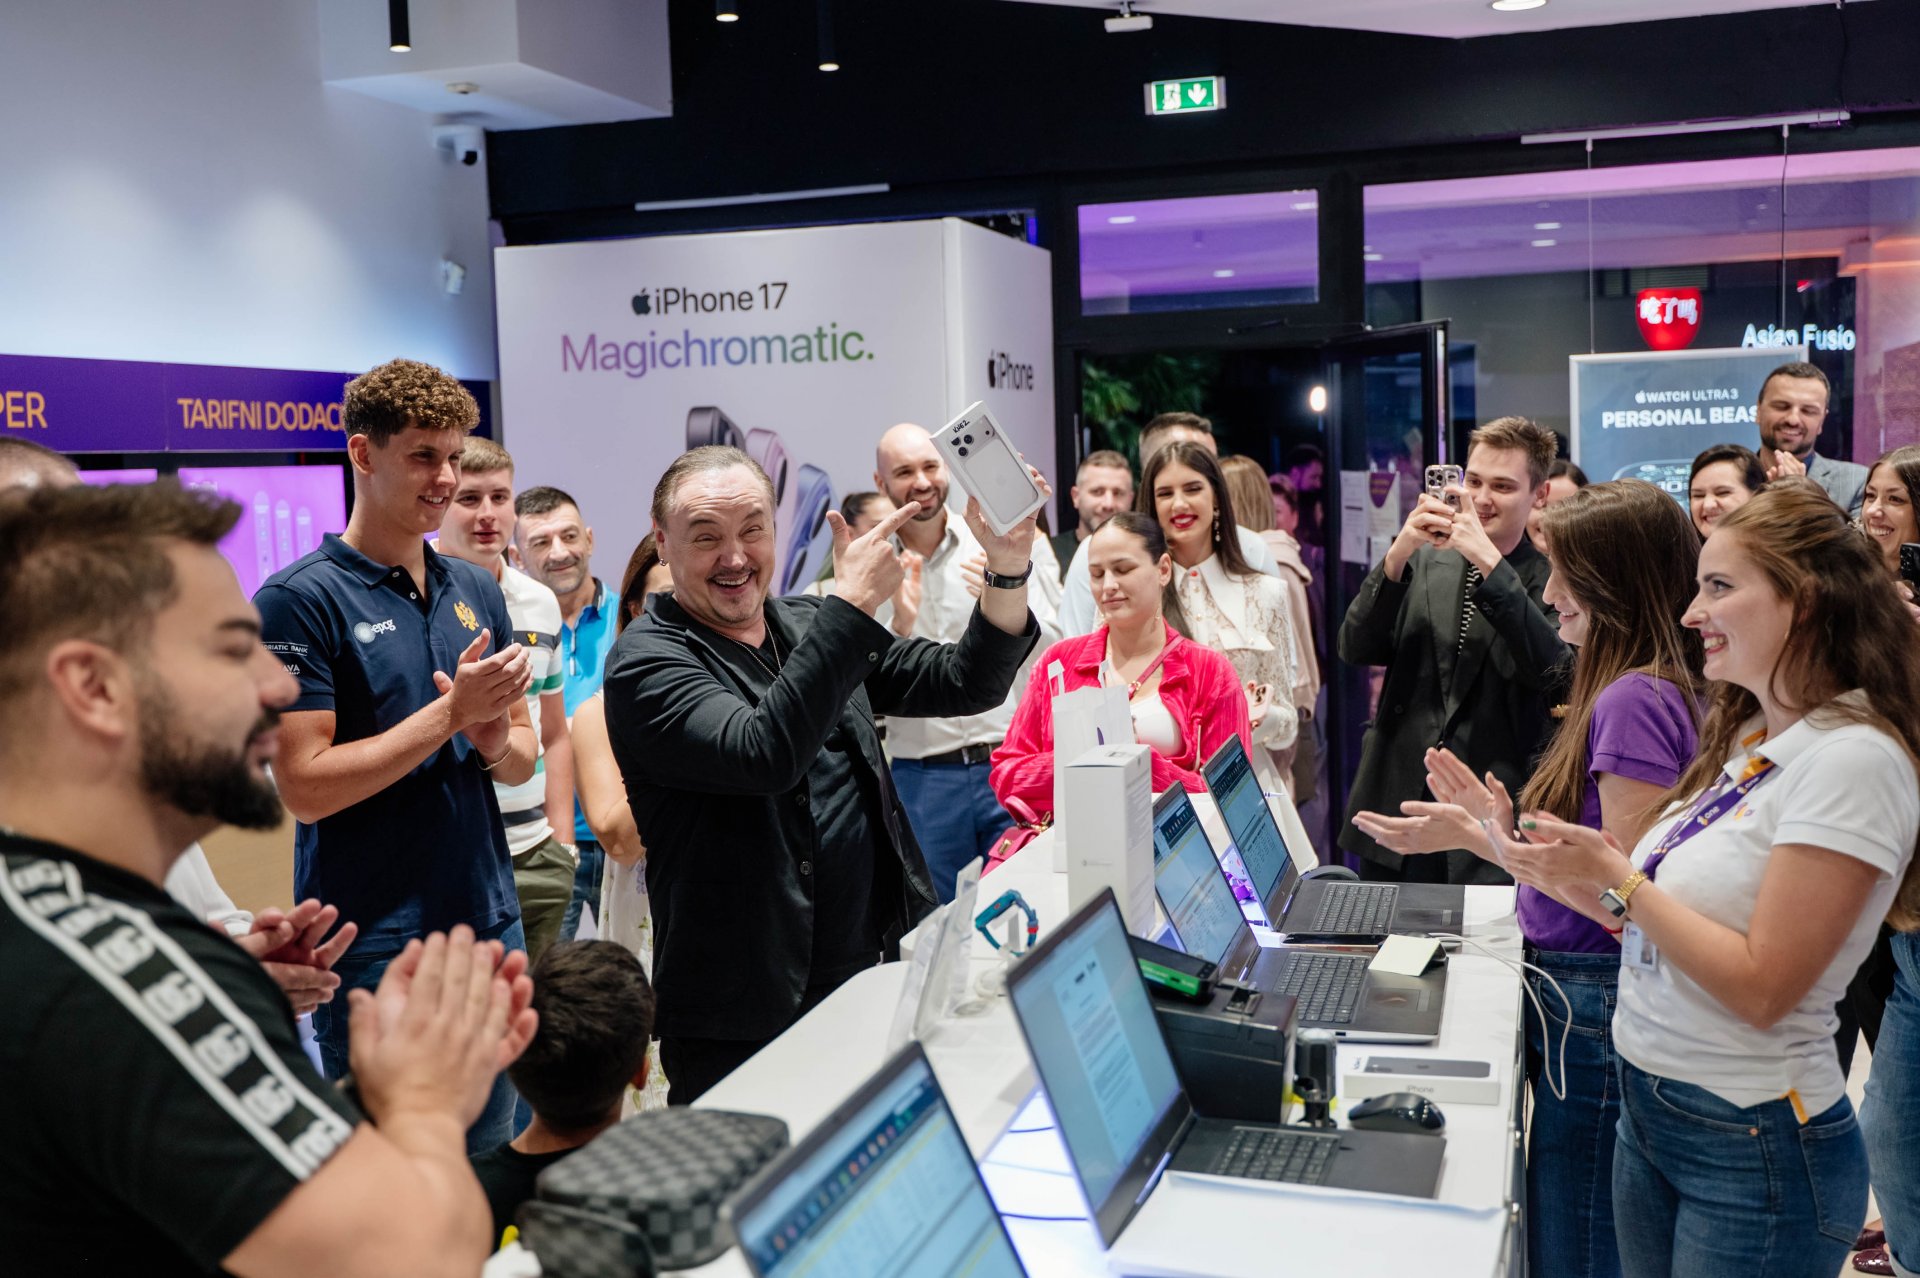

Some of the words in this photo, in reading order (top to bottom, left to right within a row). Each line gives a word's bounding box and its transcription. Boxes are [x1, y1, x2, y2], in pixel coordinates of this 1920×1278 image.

[655, 287, 754, 315] iPhone
[758, 282, 788, 310] 17
[1741, 323, 1799, 348] Asian
[561, 322, 875, 378] Magichromatic.
[996, 351, 1034, 391] iPhone
[1646, 390, 1691, 403] WATCH
[1692, 389, 1729, 401] ULTRA
[1729, 388, 1739, 400] 3
[177, 398, 262, 430] TARIFNI
[1602, 408, 1707, 429] PERSONAL
[371, 619, 397, 635] epcg
[290, 645, 308, 653] BANK
[1704, 805, 1721, 819] one
[1406, 1085, 1434, 1094] iPhone
